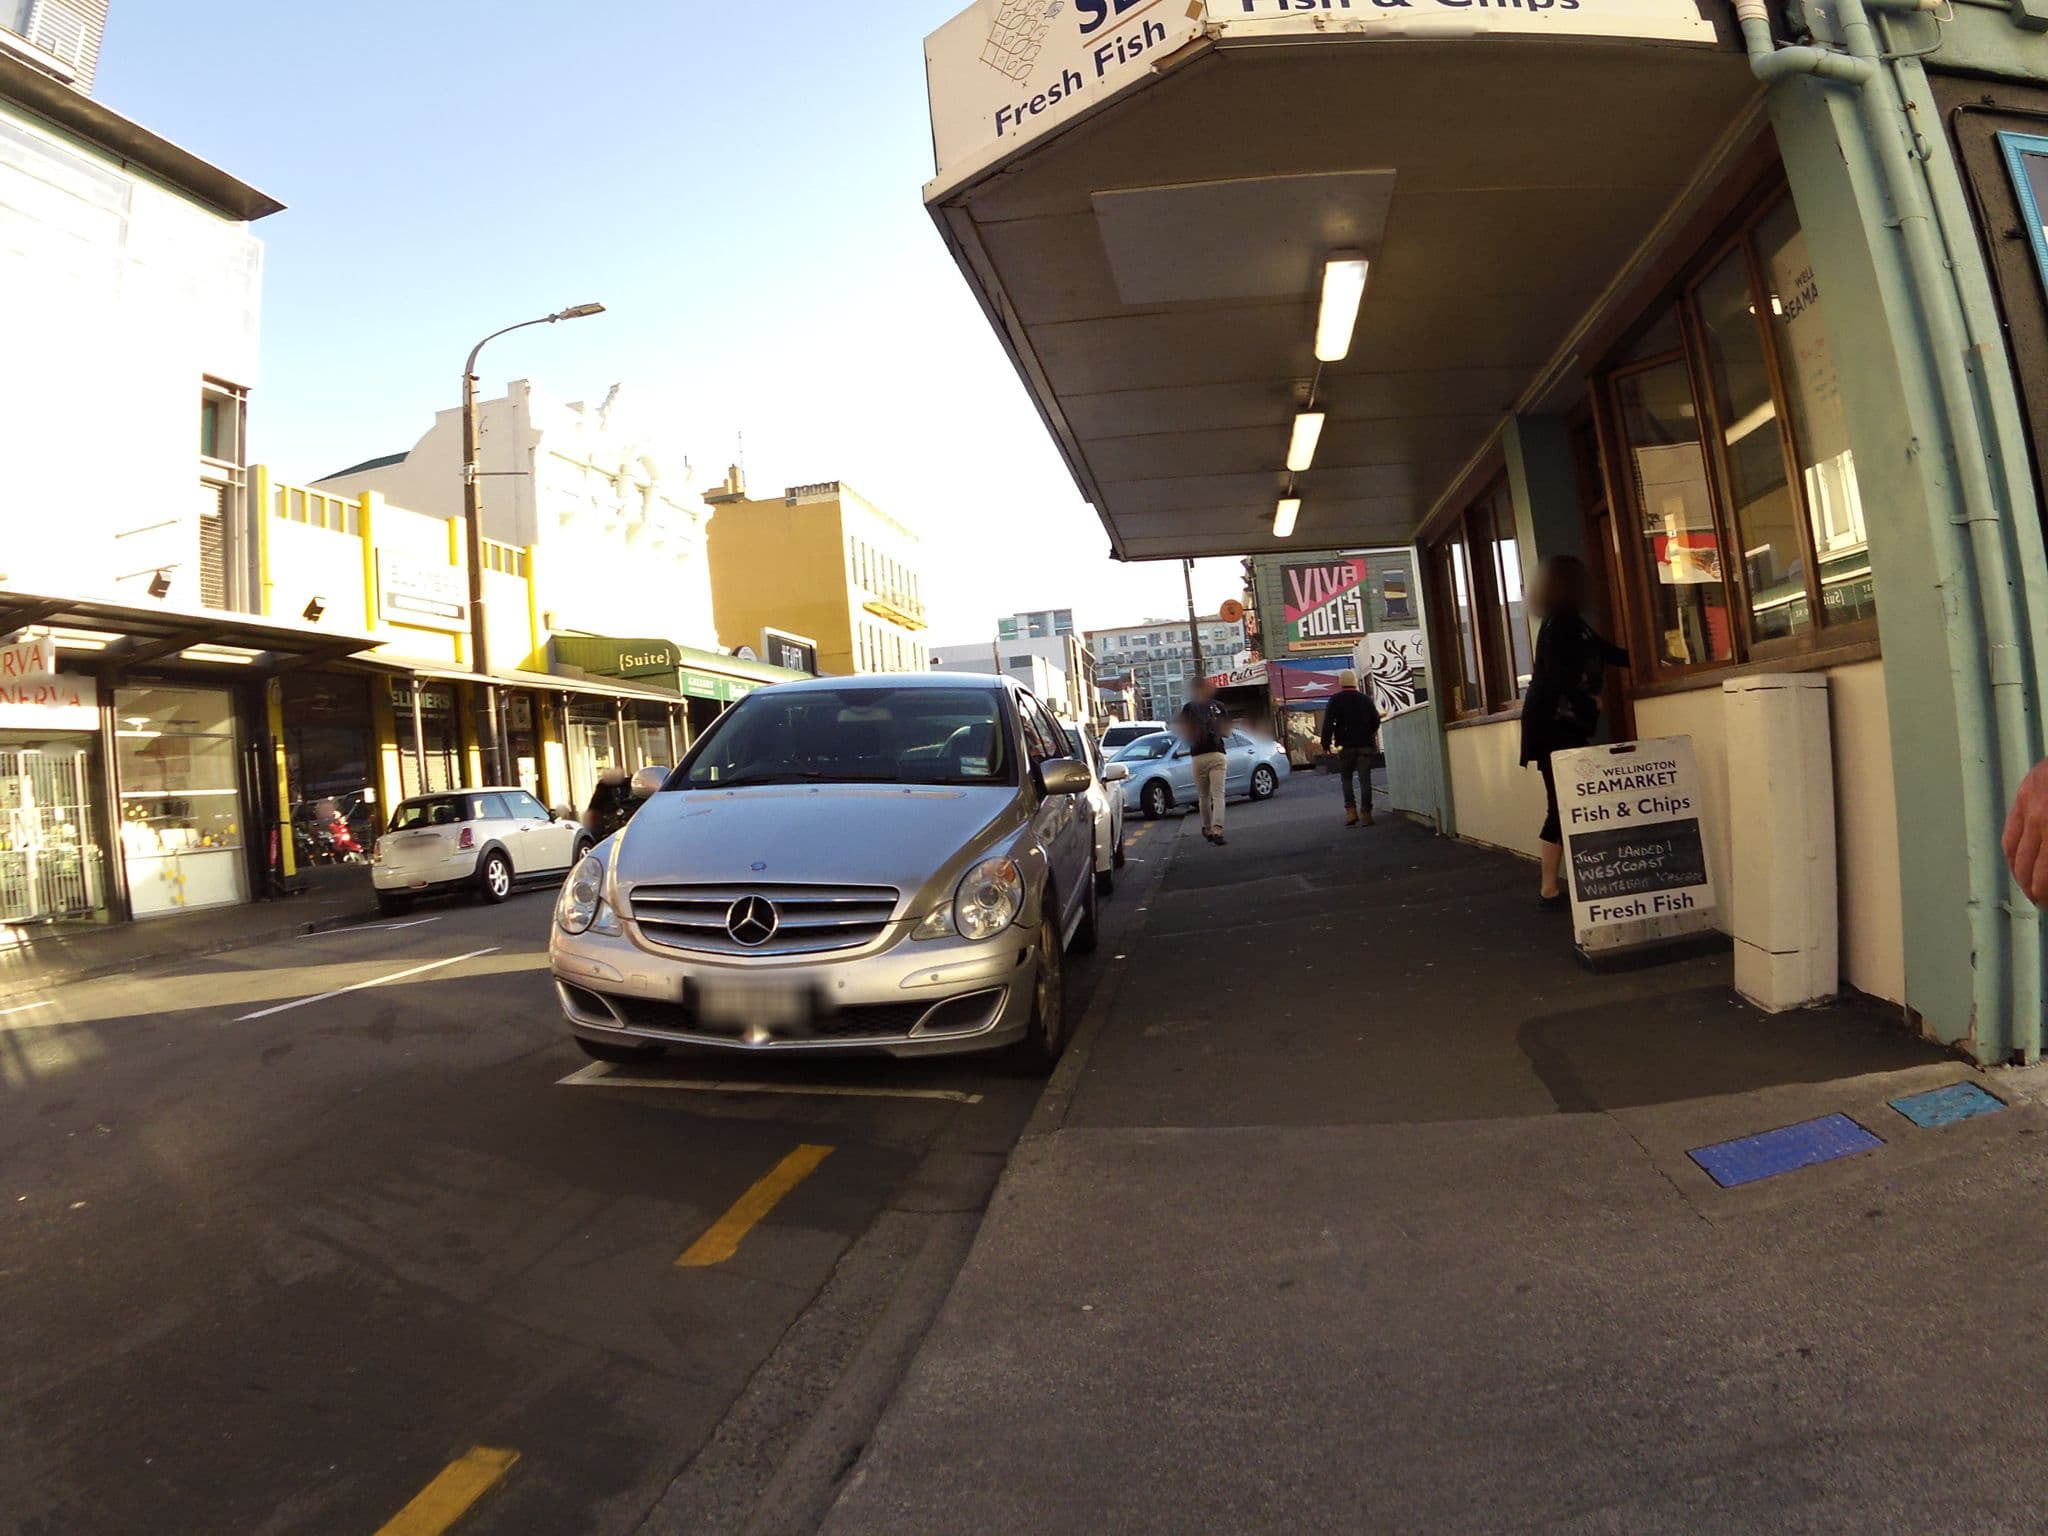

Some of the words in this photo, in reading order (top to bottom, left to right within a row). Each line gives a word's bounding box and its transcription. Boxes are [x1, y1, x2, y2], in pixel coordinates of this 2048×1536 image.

[995, 69, 1083, 137] Fresh
[1094, 20, 1166, 78] Fish
[1288, 565, 1358, 613] VIVA
[1602, 760, 1677, 777] WELLINGTON
[1576, 770, 1677, 797] SEAMARKET
[1571, 805, 1610, 824] Fish
[1617, 802, 1631, 817] &
[1638, 796, 1690, 815] Chips
[1578, 856, 1665, 881] WESTCOAST
[1589, 899, 1647, 922] Fresh
[1653, 892, 1694, 913] Fish
